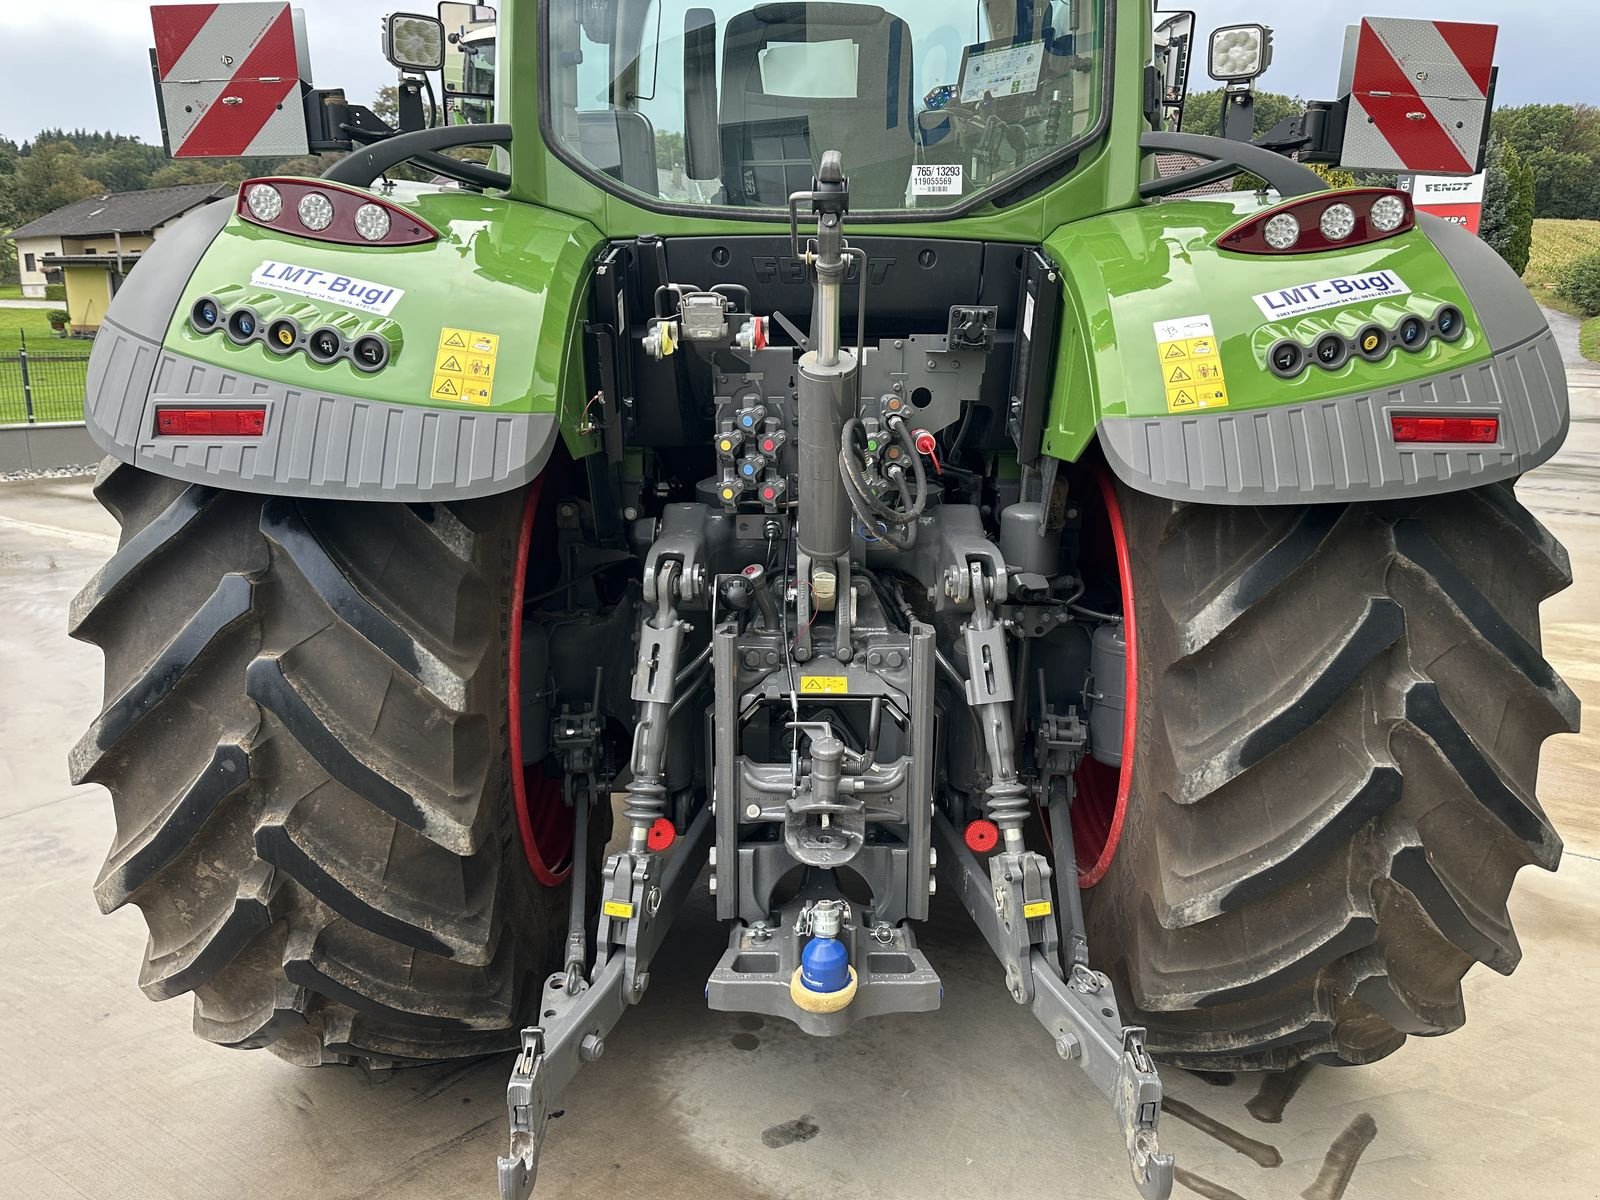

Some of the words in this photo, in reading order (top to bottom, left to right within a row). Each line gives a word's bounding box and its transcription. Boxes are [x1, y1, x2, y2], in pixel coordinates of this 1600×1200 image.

[914, 177, 952, 185] 119055569
[917, 166, 960, 177] 765/13293
[1425, 182, 1472, 192] FENDT
[752, 256, 897, 284] FEDT
[262, 263, 394, 305] LMT-Bugl
[1263, 272, 1395, 310] LMT-Bugl
